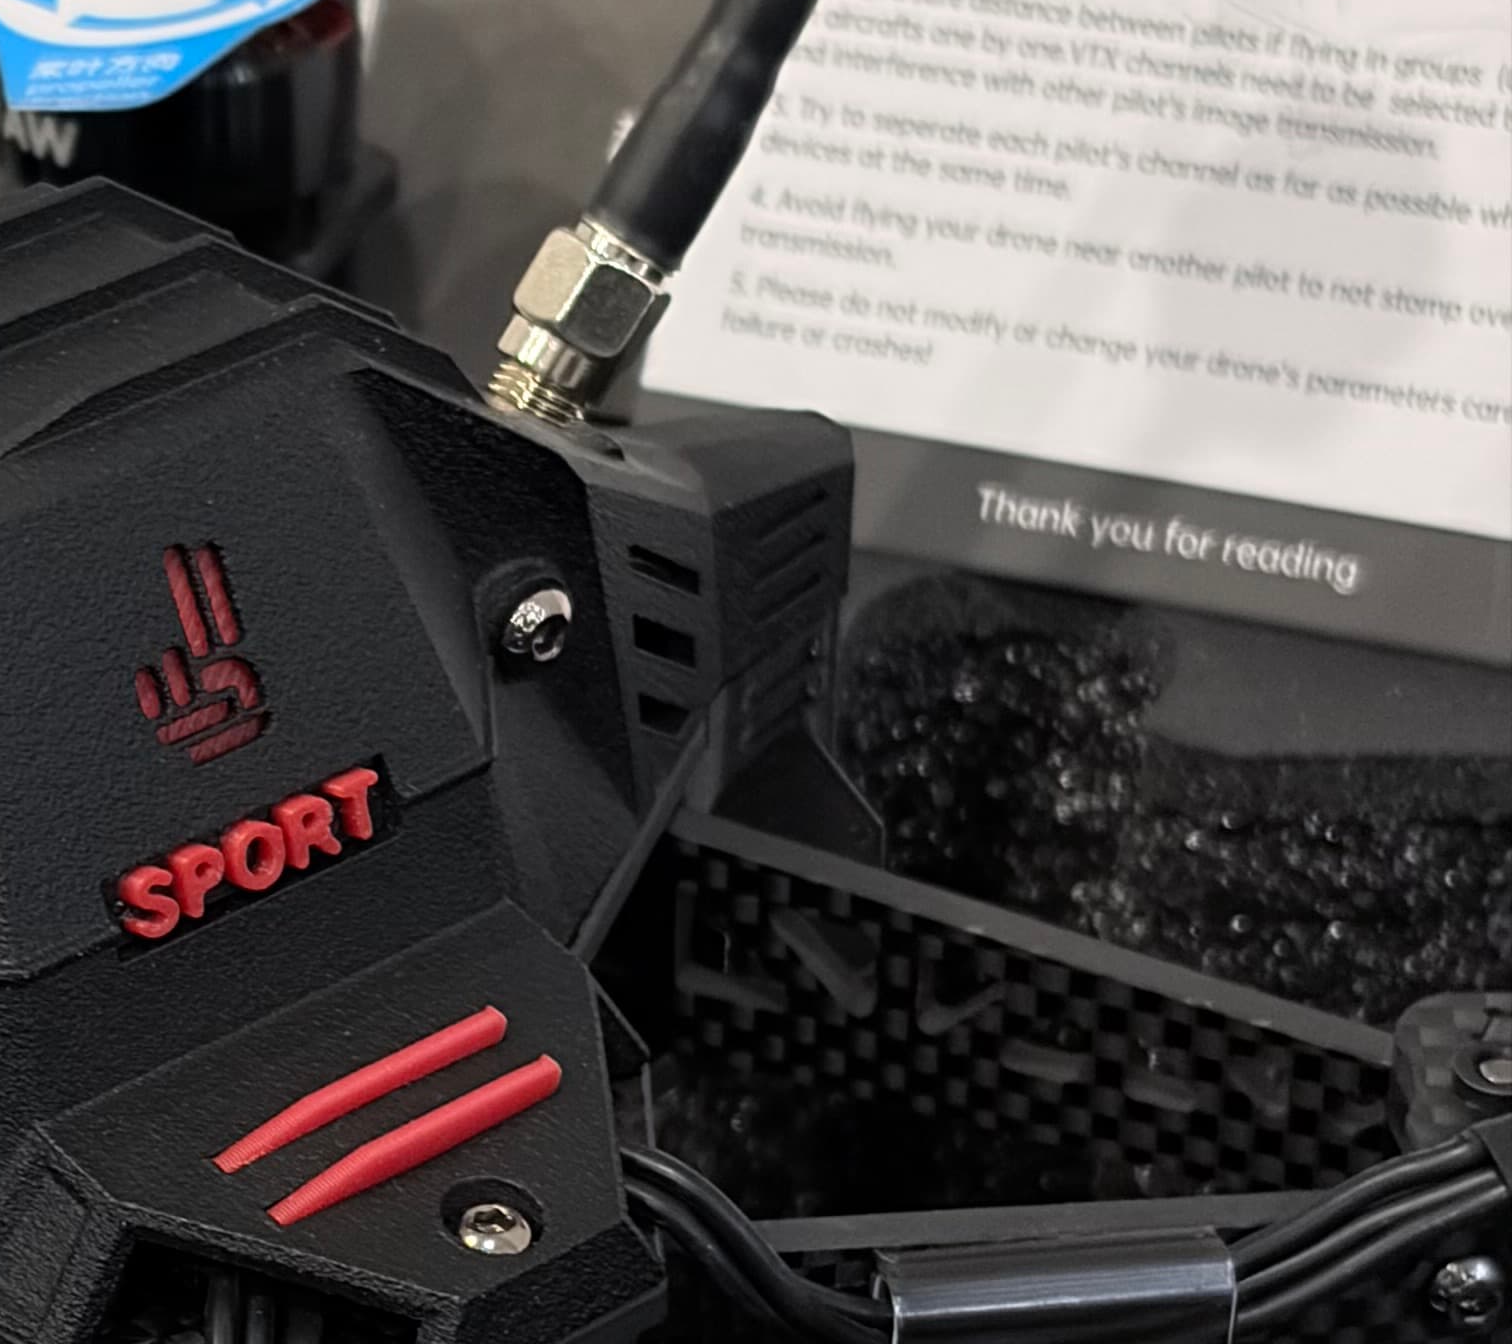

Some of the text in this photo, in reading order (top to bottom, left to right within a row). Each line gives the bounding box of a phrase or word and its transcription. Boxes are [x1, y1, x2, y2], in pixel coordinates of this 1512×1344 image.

[823, 7, 926, 43] aircrafts
[930, 23, 977, 48] one
[981, 27, 1010, 59] by
[1126, 51, 1237, 89] channels
[1241, 68, 1306, 99] need
[1311, 77, 1336, 104] to
[1342, 84, 1375, 112] be
[1389, 90, 1497, 125] selected
[833, 44, 978, 90] interference
[983, 69, 1036, 98] with
[1042, 83, 1107, 112] other
[1111, 88, 1188, 124] pilot's
[1193, 98, 1272, 138] image
[1276, 109, 1440, 160] transmission.
[1077, 4, 1186, 42] between
[1190, 21, 1262, 56] pilots
[1265, 29, 1284, 54] if
[1288, 30, 1360, 72] flying
[1365, 47, 1389, 70] in
[1392, 56, 1484, 88] groups
[759, 130, 1072, 202] devices at the same time.
[799, 94, 834, 124] Try
[841, 103, 866, 127] to
[988, 128, 1051, 159] each
[1054, 137, 1131, 176] pilot's
[1136, 151, 1239, 189] channel
[1244, 168, 1276, 193] as
[1282, 172, 1320, 199] far
[1326, 183, 1358, 206] as
[1362, 190, 1473, 225] possible
[740, 221, 897, 271] transmission.
[774, 186, 846, 221] Avoid
[851, 199, 919, 241] flying
[925, 217, 981, 252] your
[986, 223, 1059, 256] drone
[1065, 238, 1121, 268] near
[1128, 249, 1229, 282] another
[1232, 261, 1293, 295] pilot
[1298, 269, 1325, 299] to
[1329, 281, 1376, 308] not
[1380, 289, 1465, 328] stomp
[721, 305, 935, 368] failure or crashes!
[755, 272, 835, 311] Please
[839, 288, 872, 316] do
[877, 300, 919, 327] not
[924, 308, 1009, 345] modify
[1013, 317, 1038, 343] or
[1045, 324, 1137, 368] change
[1143, 343, 1201, 377] your
[1205, 348, 1301, 390] drone's
[1304, 368, 1458, 417] parameters
[976, 485, 1360, 597] Thank you for reading
[118, 767, 380, 940] SPORT
